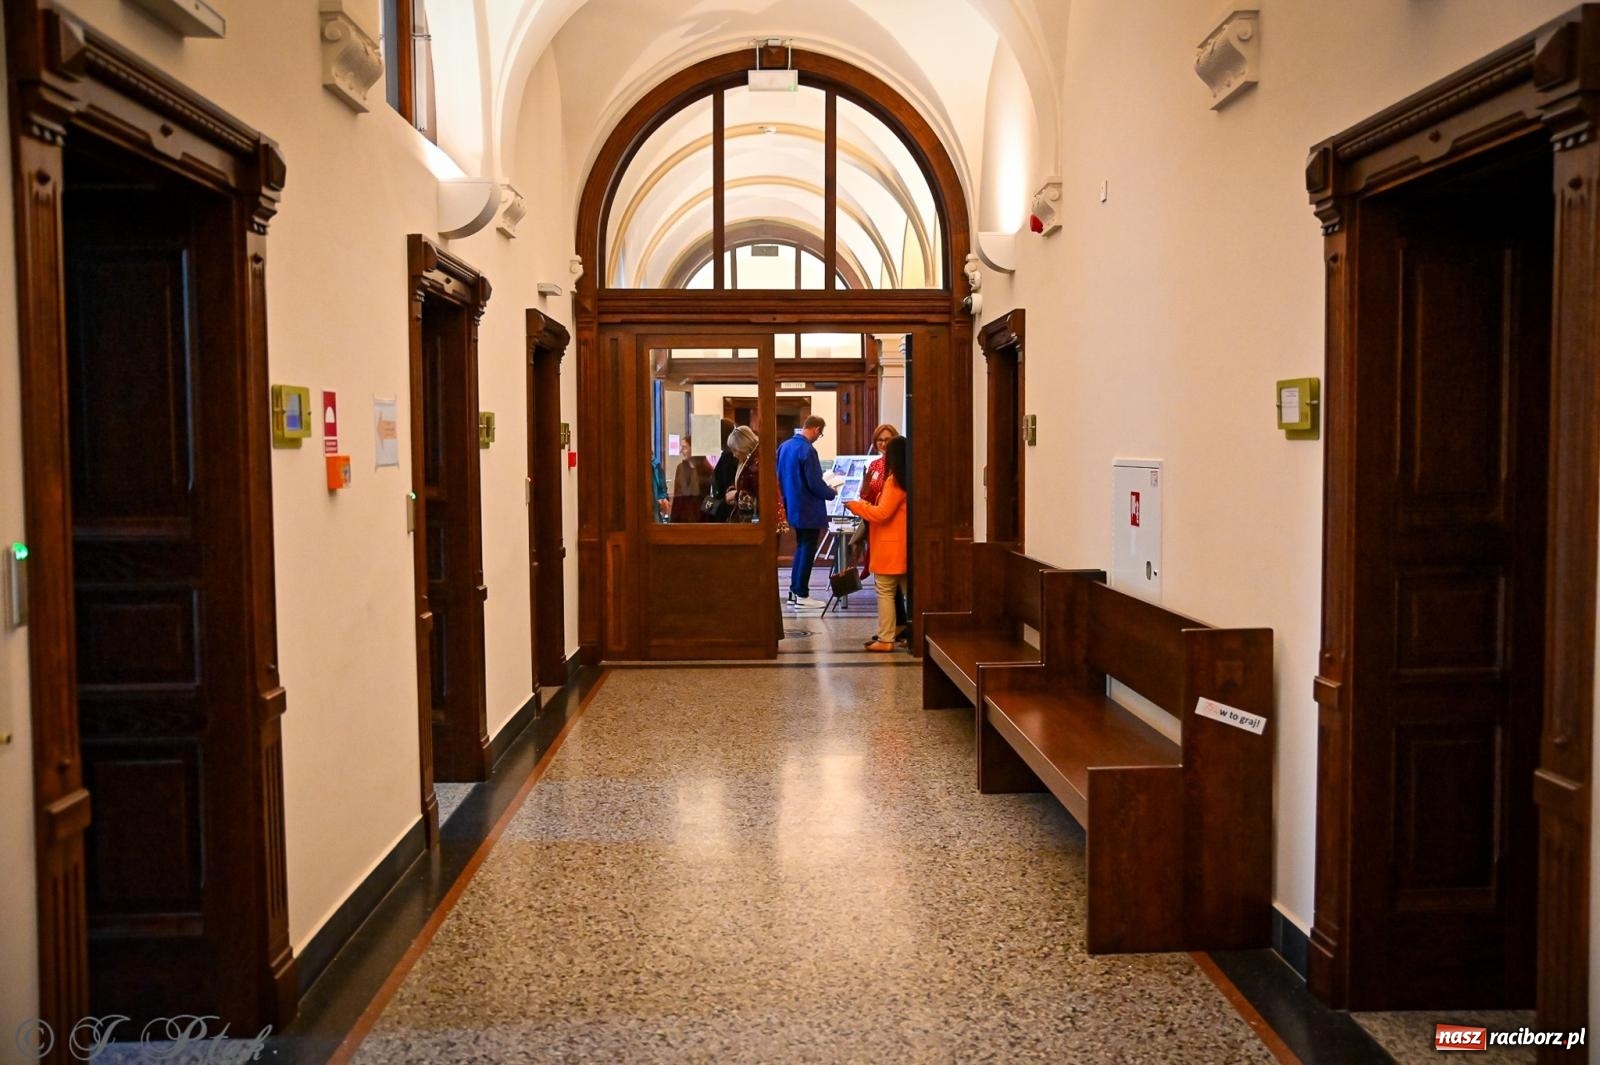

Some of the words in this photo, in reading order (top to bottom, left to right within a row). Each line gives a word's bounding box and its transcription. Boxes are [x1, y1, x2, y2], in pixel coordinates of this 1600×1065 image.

[1219, 708, 1228, 717] w
[1229, 711, 1239, 721] to
[1239, 716, 1261, 728] graj!
